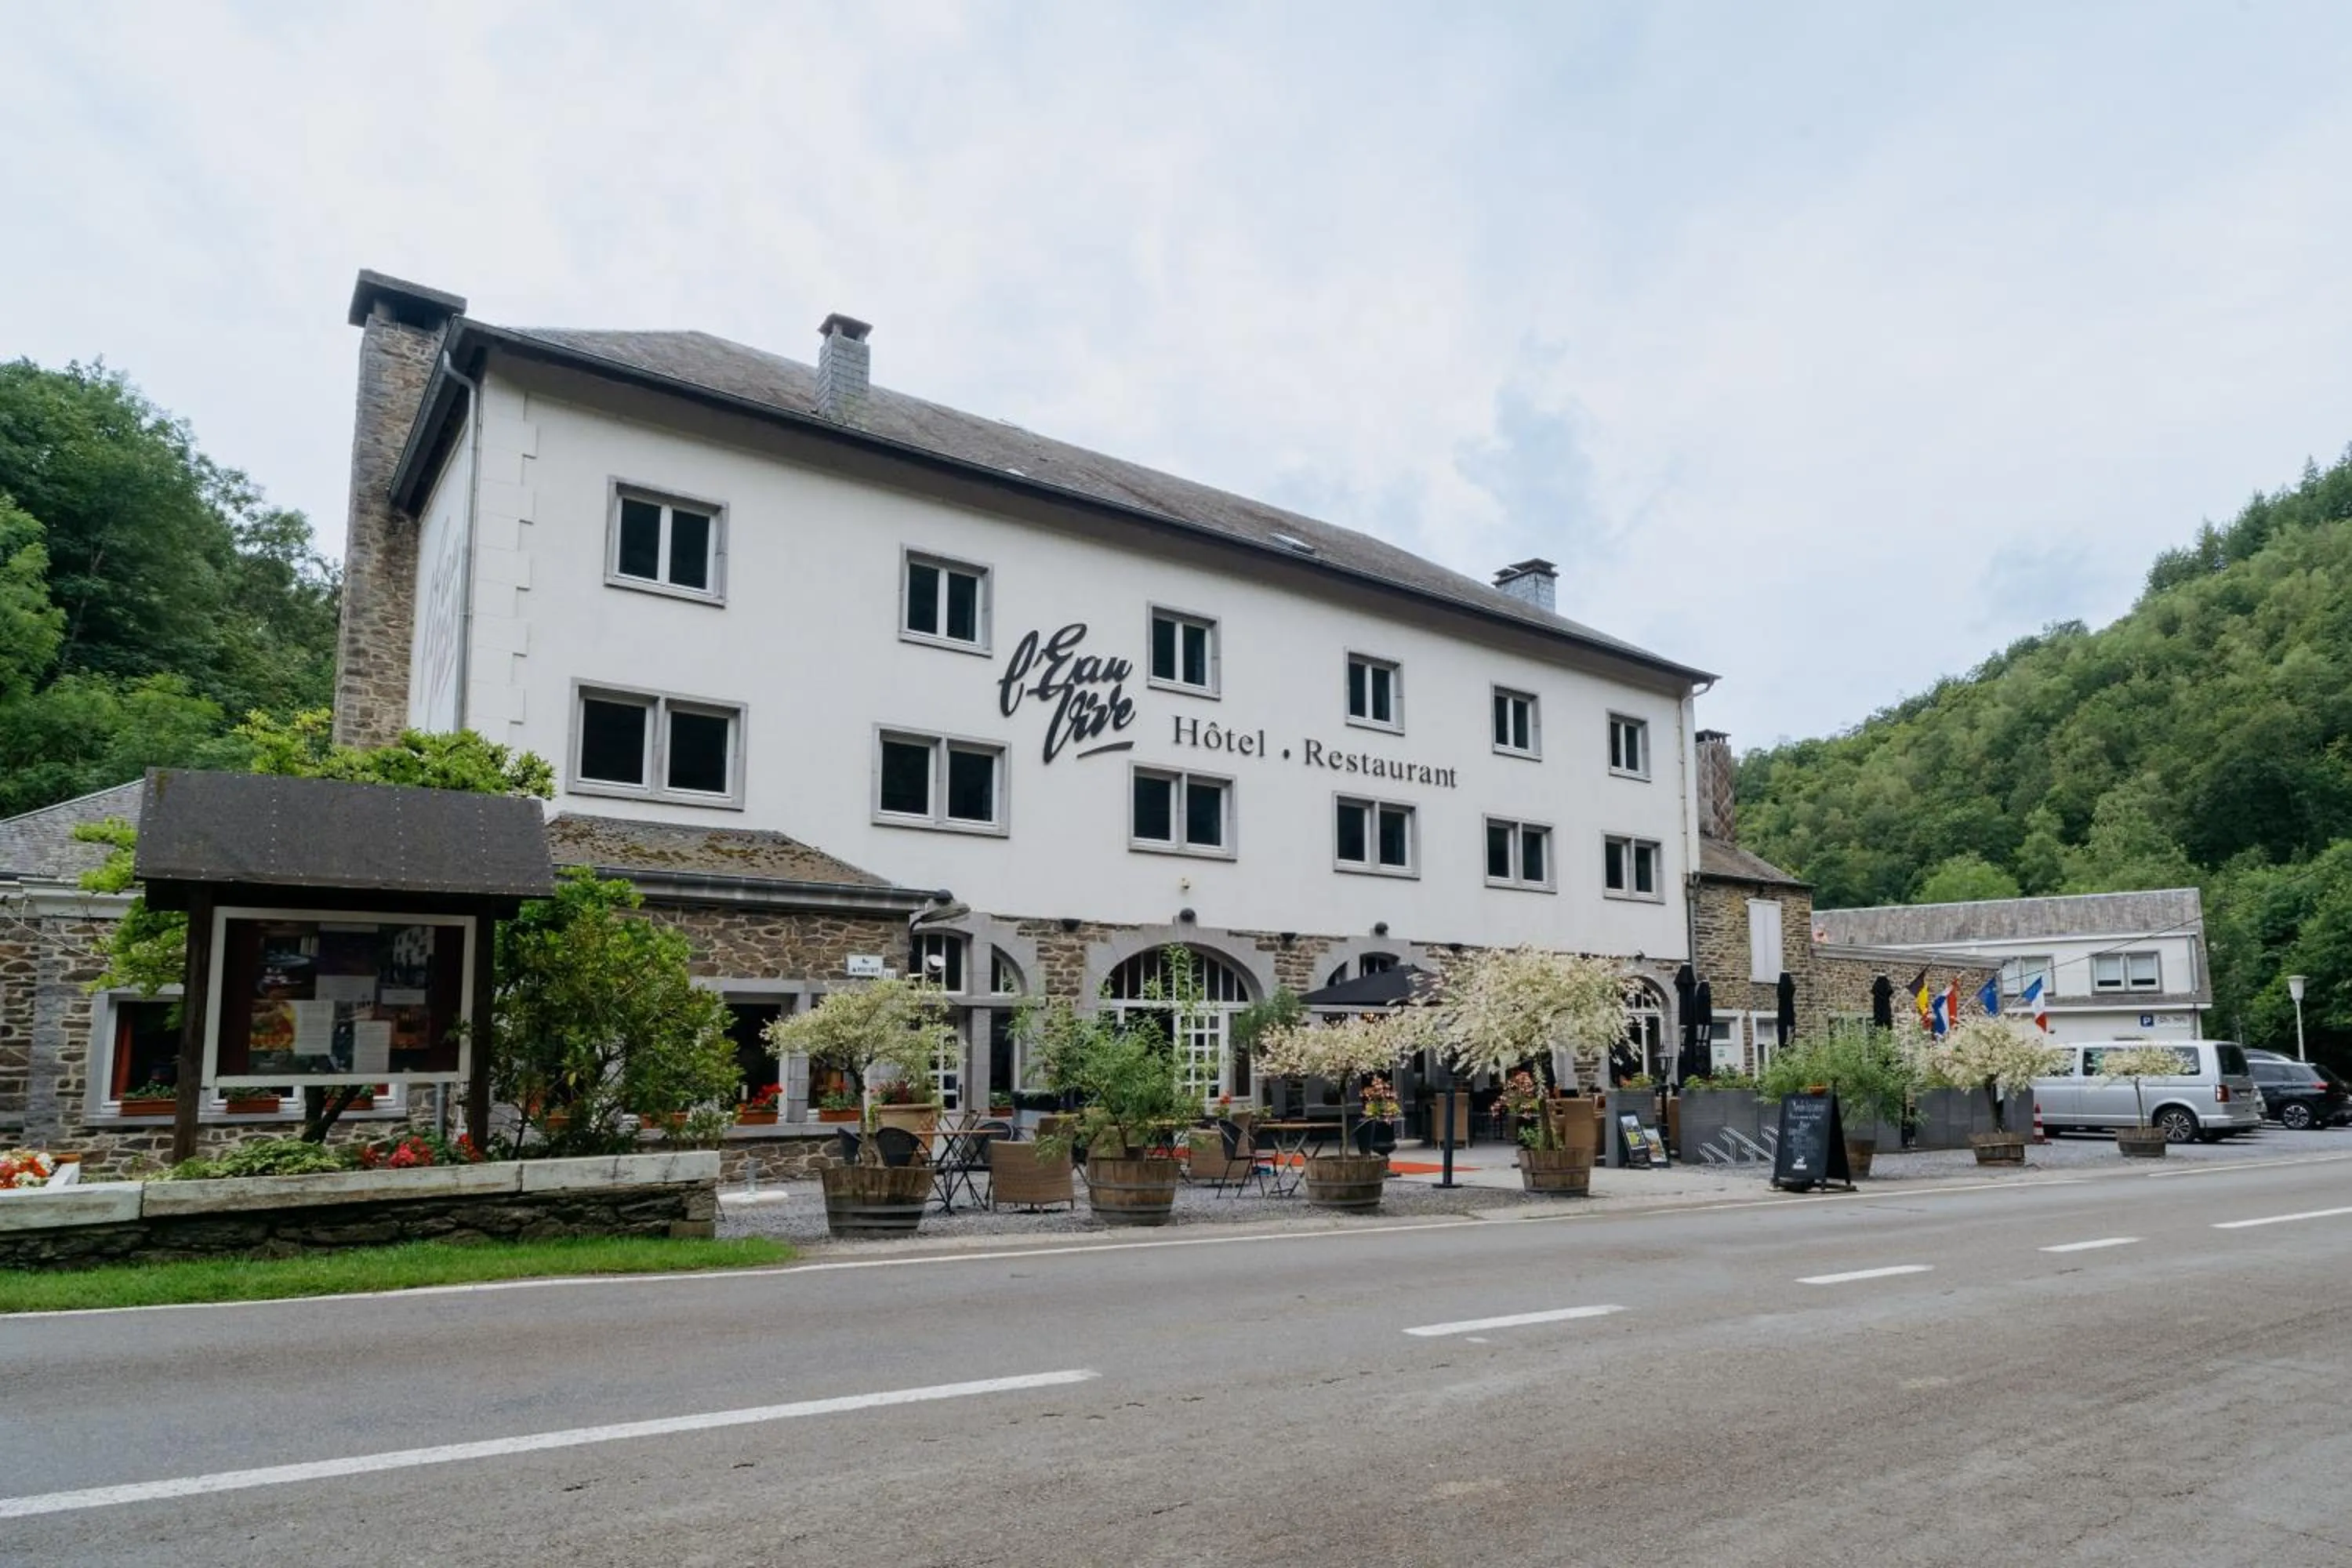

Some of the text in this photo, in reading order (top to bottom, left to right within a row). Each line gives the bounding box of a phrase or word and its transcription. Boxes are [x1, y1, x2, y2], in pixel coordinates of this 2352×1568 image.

[1043, 683, 1136, 766] Vive
[1173, 714, 1457, 788] Hôtel Restaurant
[2143, 1017, 2151, 1025] P
